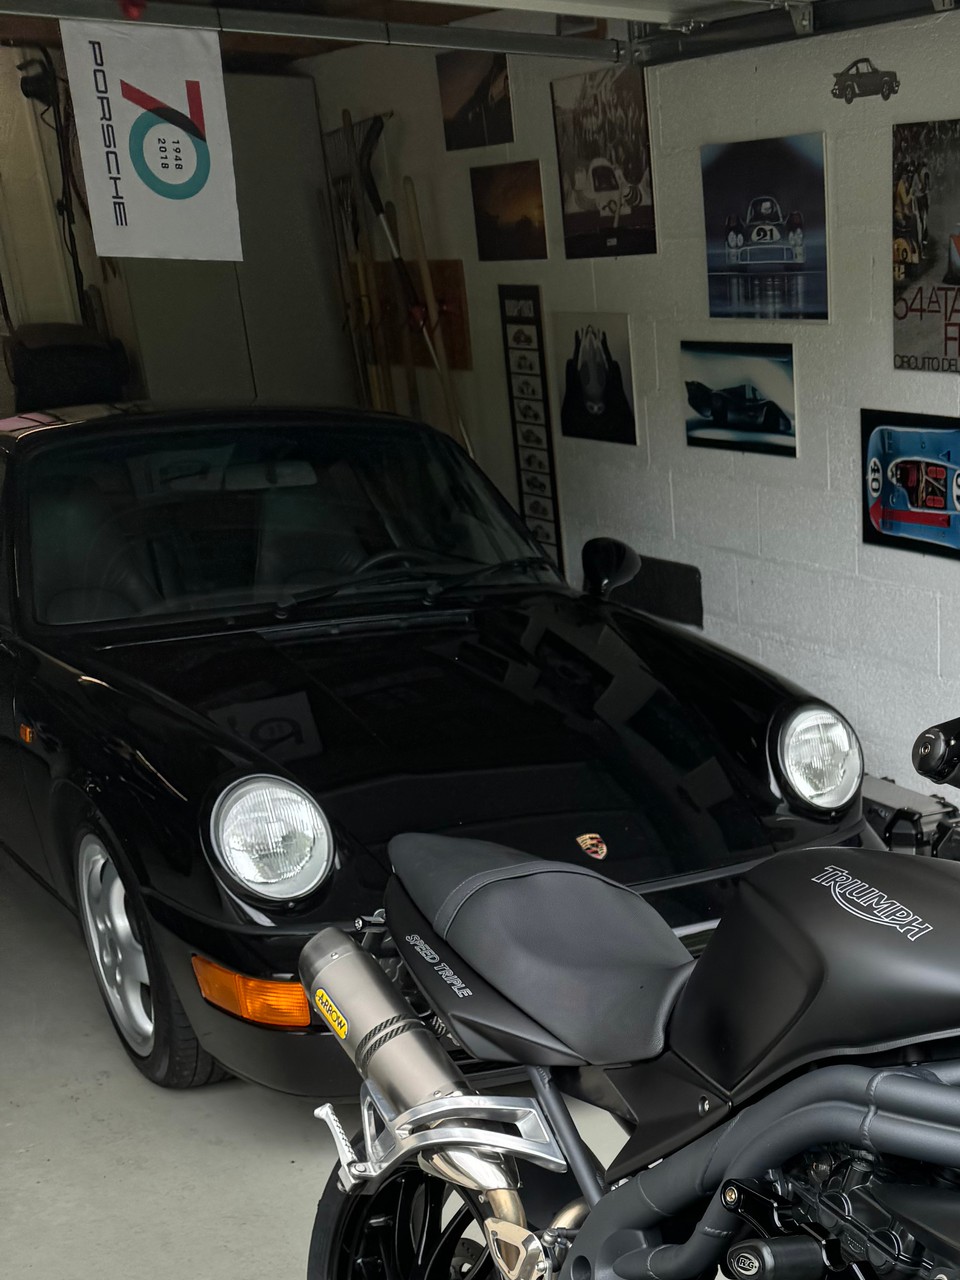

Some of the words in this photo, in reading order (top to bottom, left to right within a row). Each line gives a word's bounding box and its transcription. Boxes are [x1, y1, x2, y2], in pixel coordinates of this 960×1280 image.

[88, 40, 128, 226] PORSCHE
[157, 137, 169, 170] 2018
[171, 139, 184, 170] 1948
[756, 227, 774, 241] 21
[870, 460, 882, 494] 40
[811, 865, 933, 941] TRIUMPH
[406, 934, 440, 963] SPEED
[434, 963, 473, 998] TRIPLE
[316, 994, 346, 1031] ARROW
